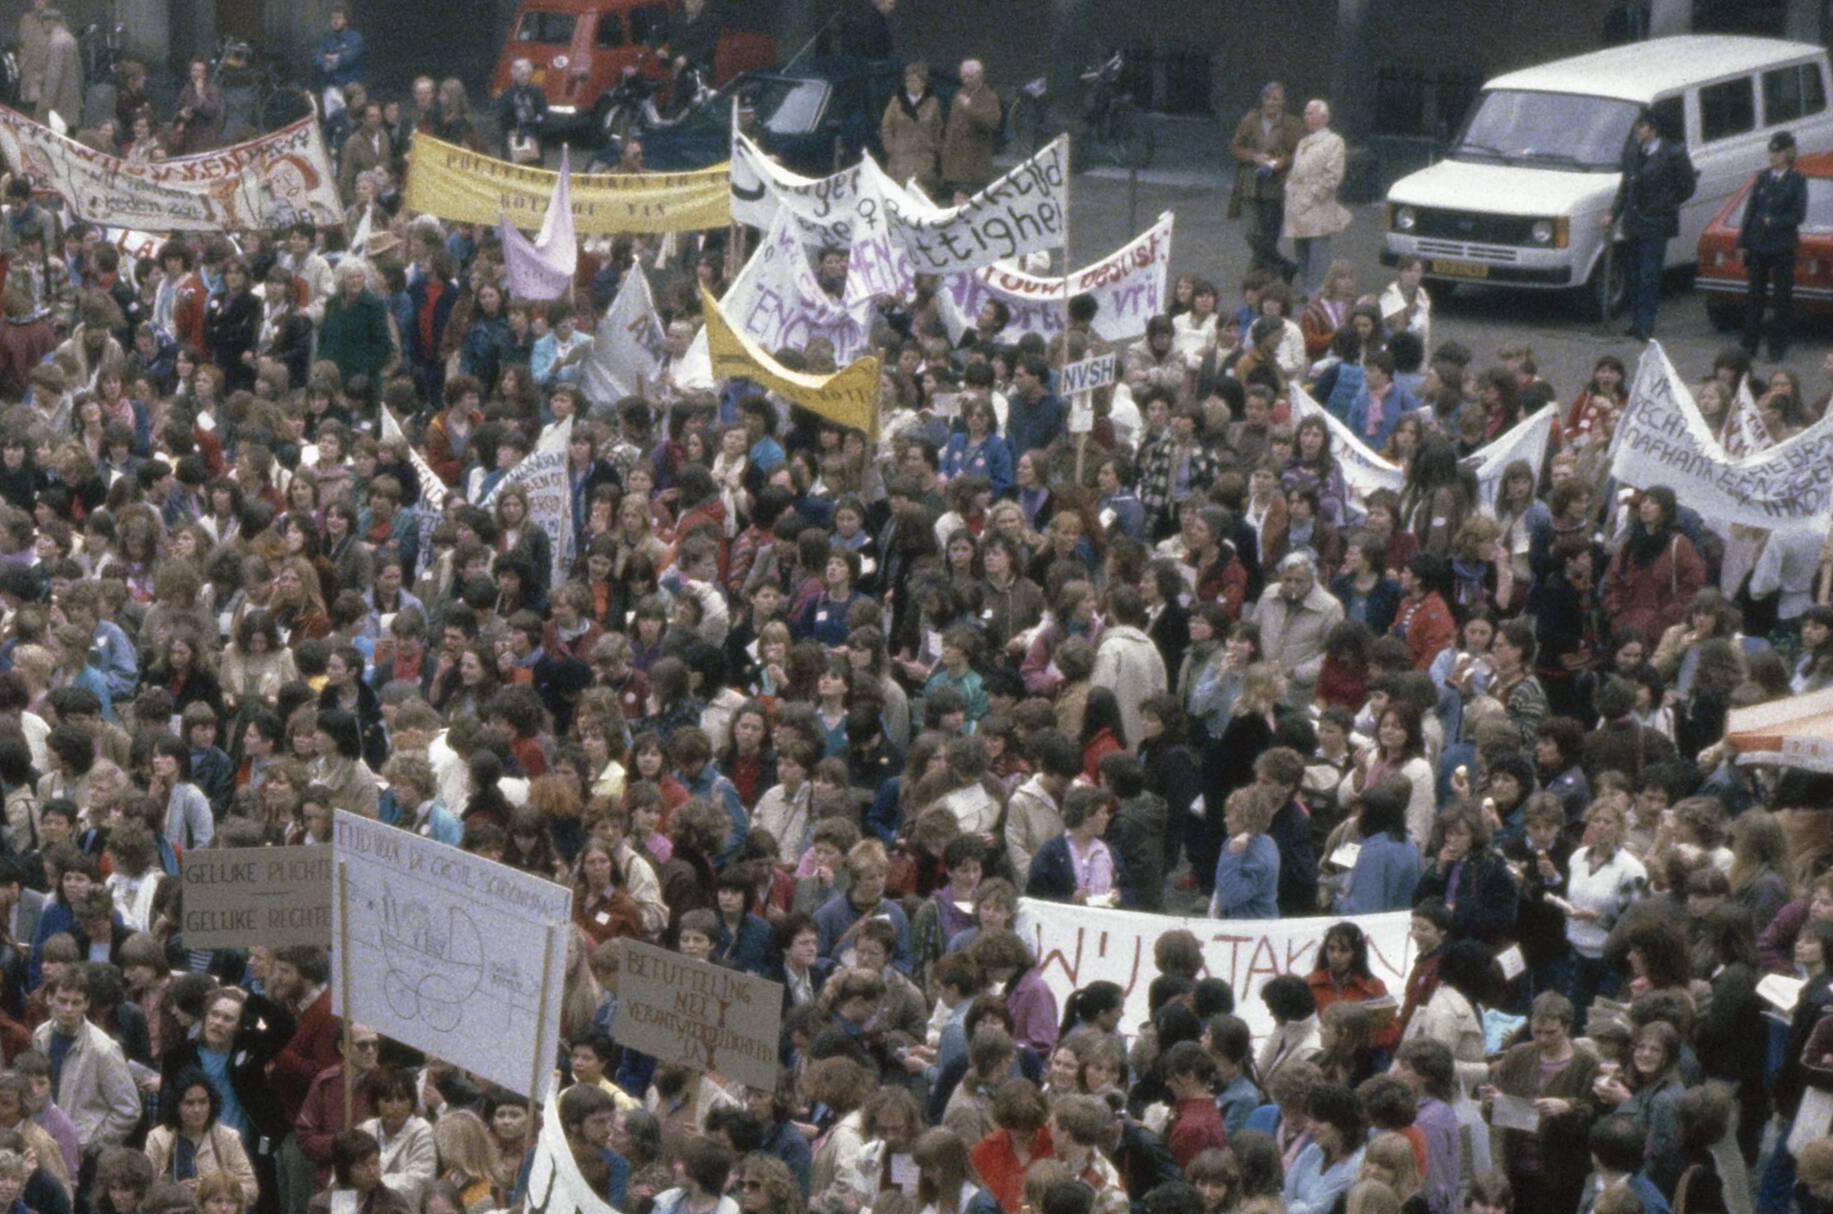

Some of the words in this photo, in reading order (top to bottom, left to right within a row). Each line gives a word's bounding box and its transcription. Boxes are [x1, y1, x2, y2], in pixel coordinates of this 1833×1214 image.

[1063, 357, 1114, 393] NVSH
[185, 862, 257, 885] GELIJKE
[185, 909, 257, 933] GELIJKE
